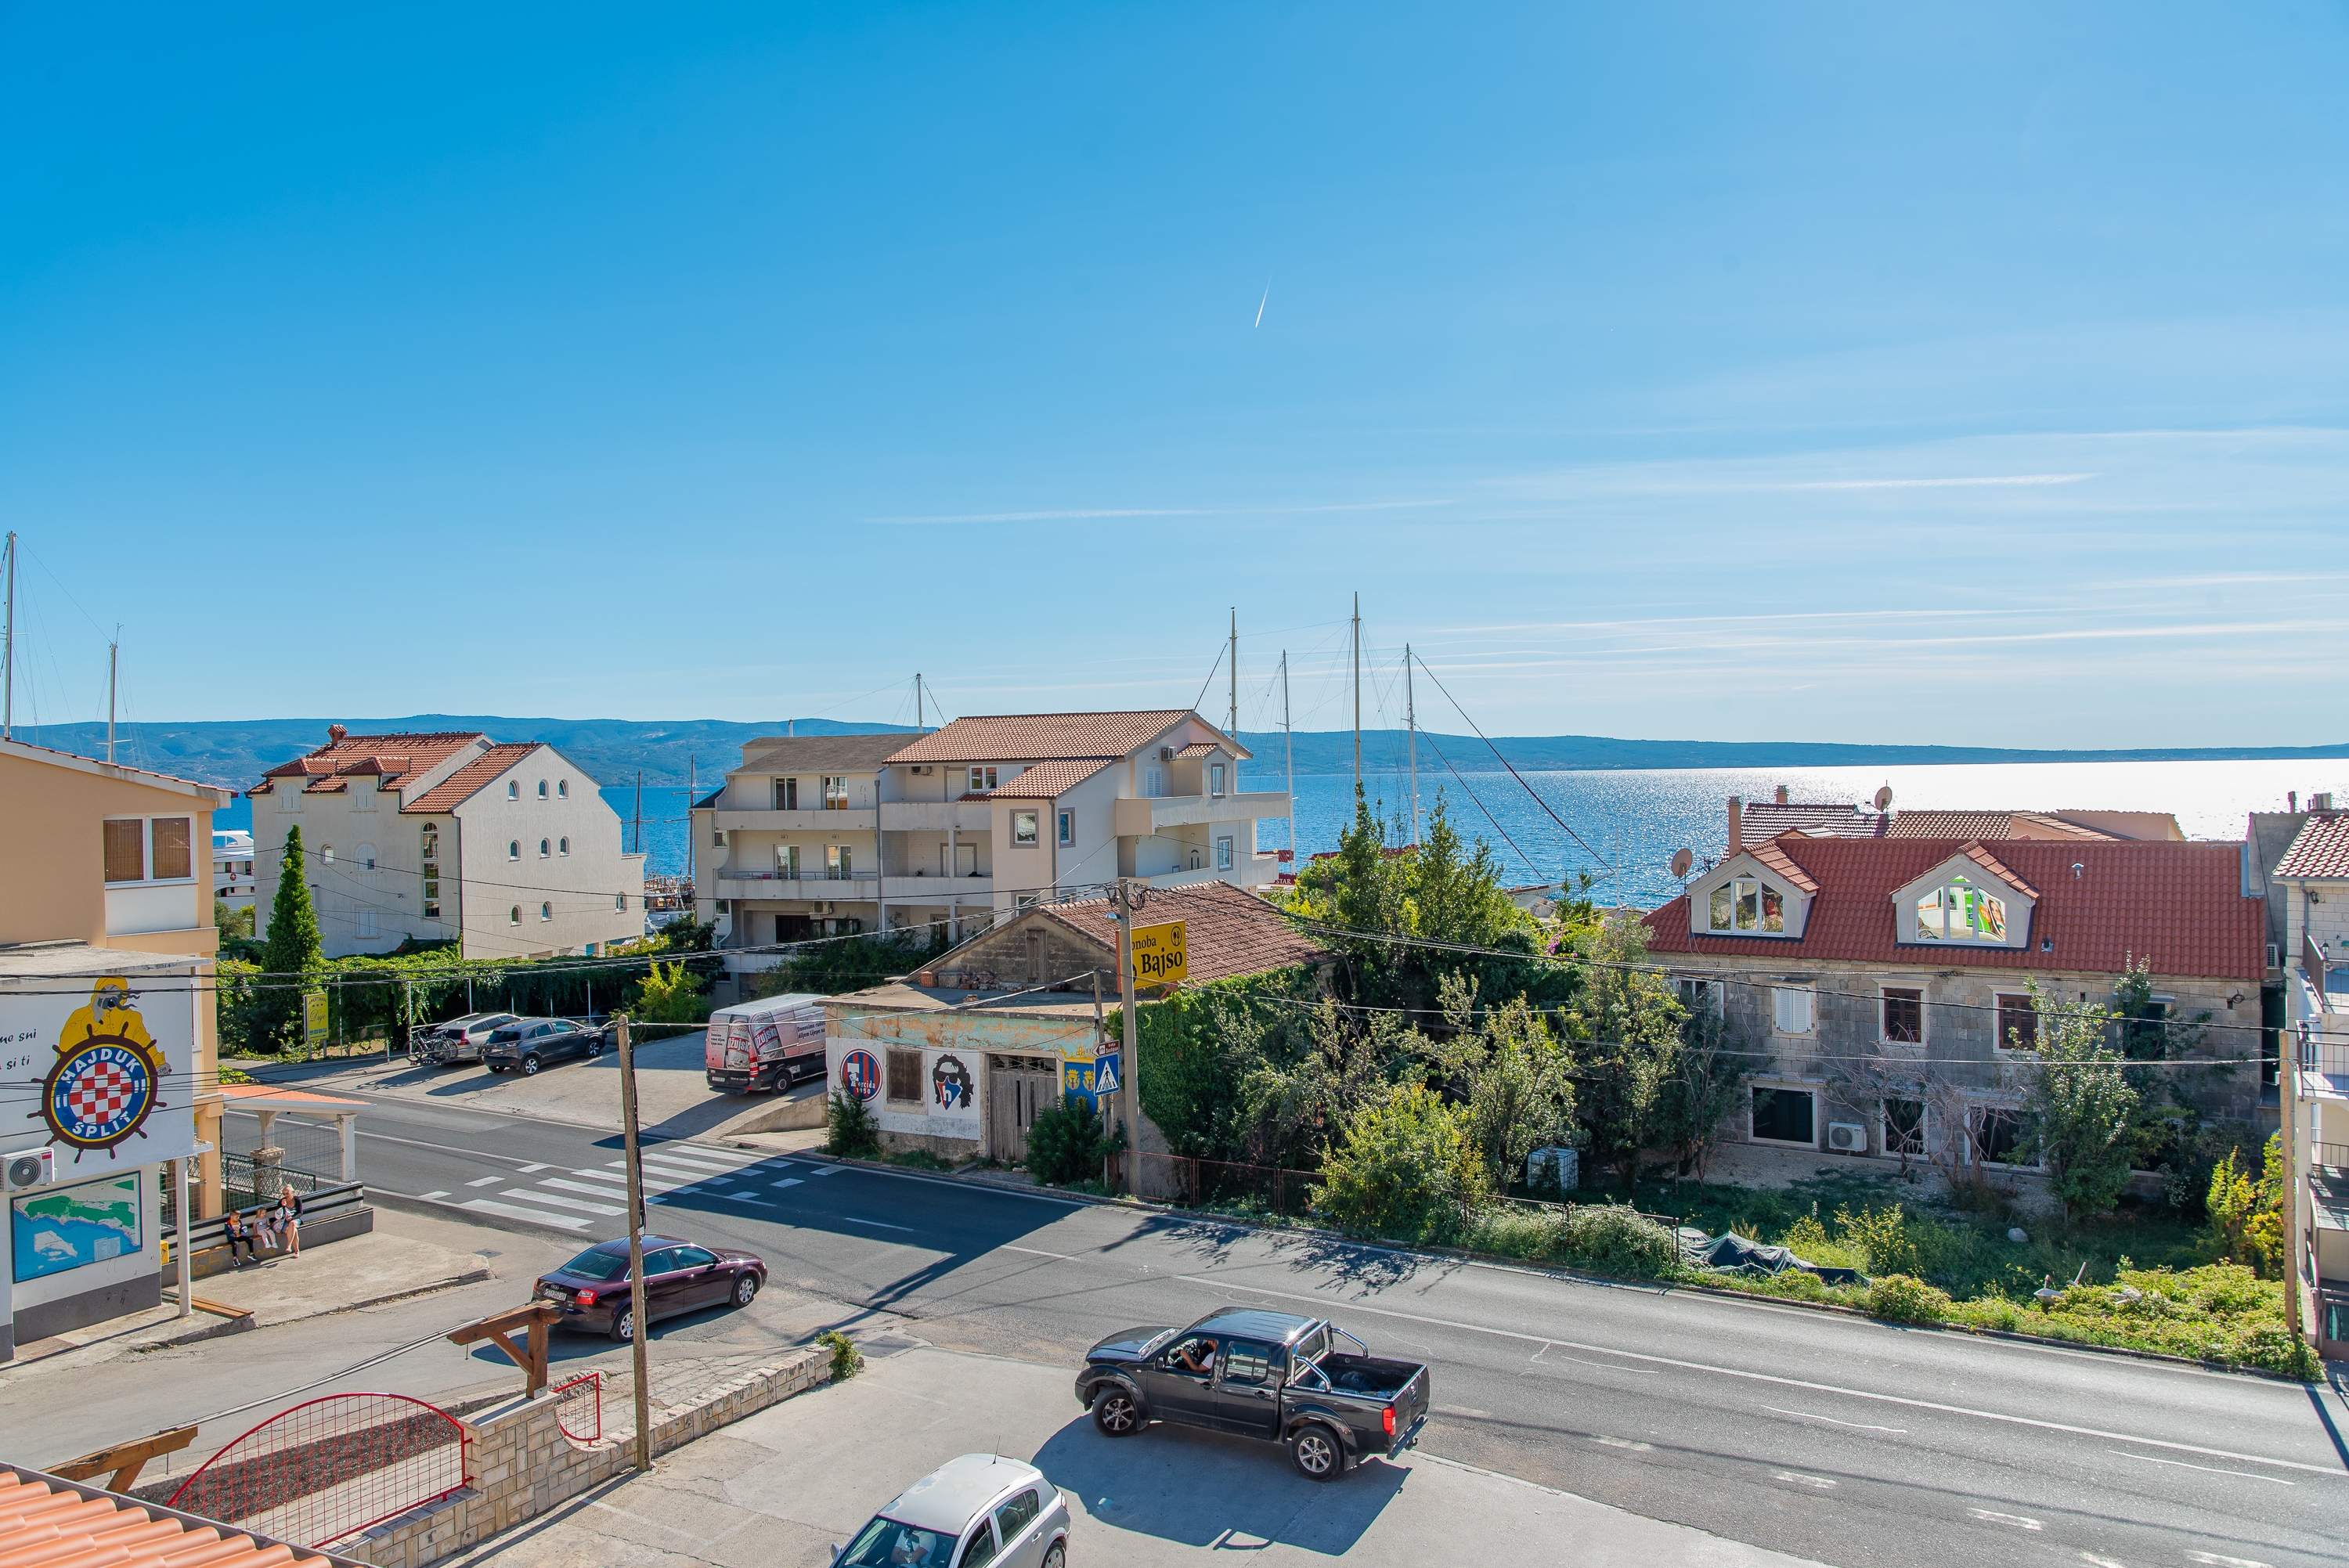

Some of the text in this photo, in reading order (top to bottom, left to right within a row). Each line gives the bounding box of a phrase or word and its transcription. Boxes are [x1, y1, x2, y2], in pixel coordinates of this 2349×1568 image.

[1131, 935, 1156, 950] onoba
[1141, 947, 1182, 977] Bajso
[18, 1028, 36, 1042] sni
[6, 1054, 30, 1069] si ti
[60, 1048, 140, 1083] HAJDUK
[942, 1085, 952, 1102] h
[72, 1111, 131, 1137] SPLIT
